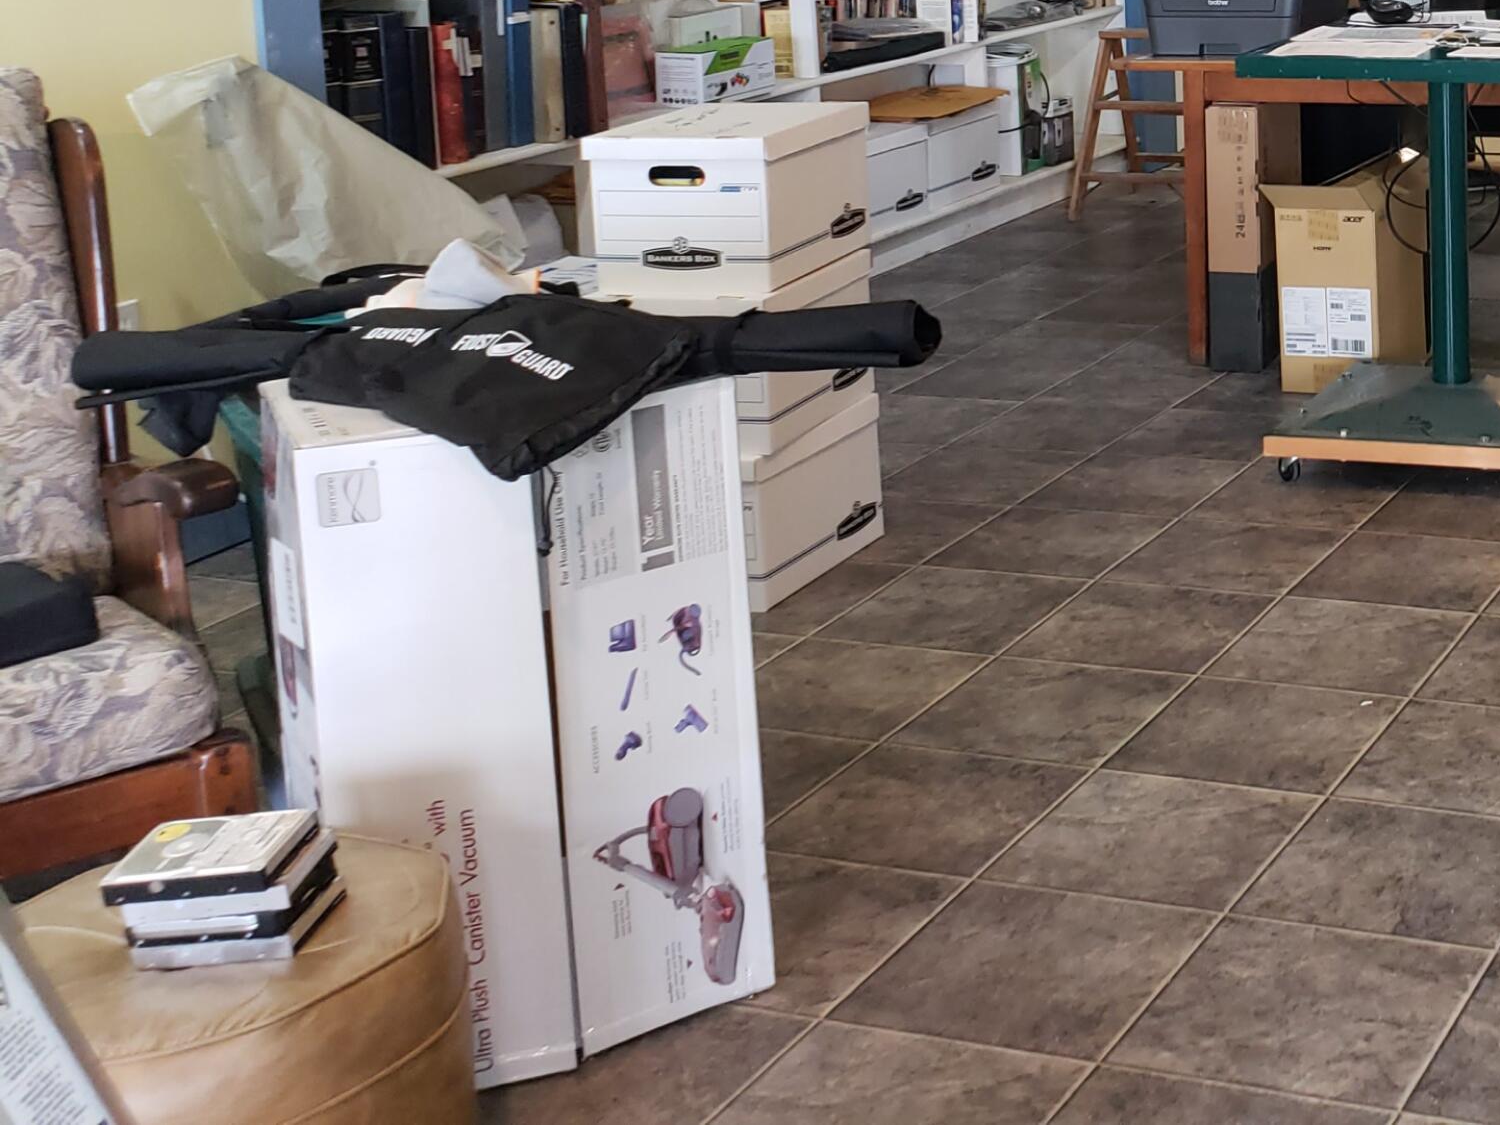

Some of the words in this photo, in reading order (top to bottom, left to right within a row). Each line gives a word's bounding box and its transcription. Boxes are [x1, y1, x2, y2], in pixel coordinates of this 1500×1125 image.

[647, 254, 693, 263] BANKERS
[695, 255, 717, 263] BOX
[511, 348, 575, 381] GUARD
[326, 476, 340, 523] Kenmore
[554, 497, 564, 516] Use
[555, 517, 568, 568] Household
[641, 515, 654, 545] Year
[559, 571, 570, 586] For
[425, 799, 447, 837] with
[459, 809, 478, 886] Vacuum
[464, 891, 485, 966] Canister
[470, 978, 490, 1022] Plush
[474, 1028, 494, 1072] Ultra
